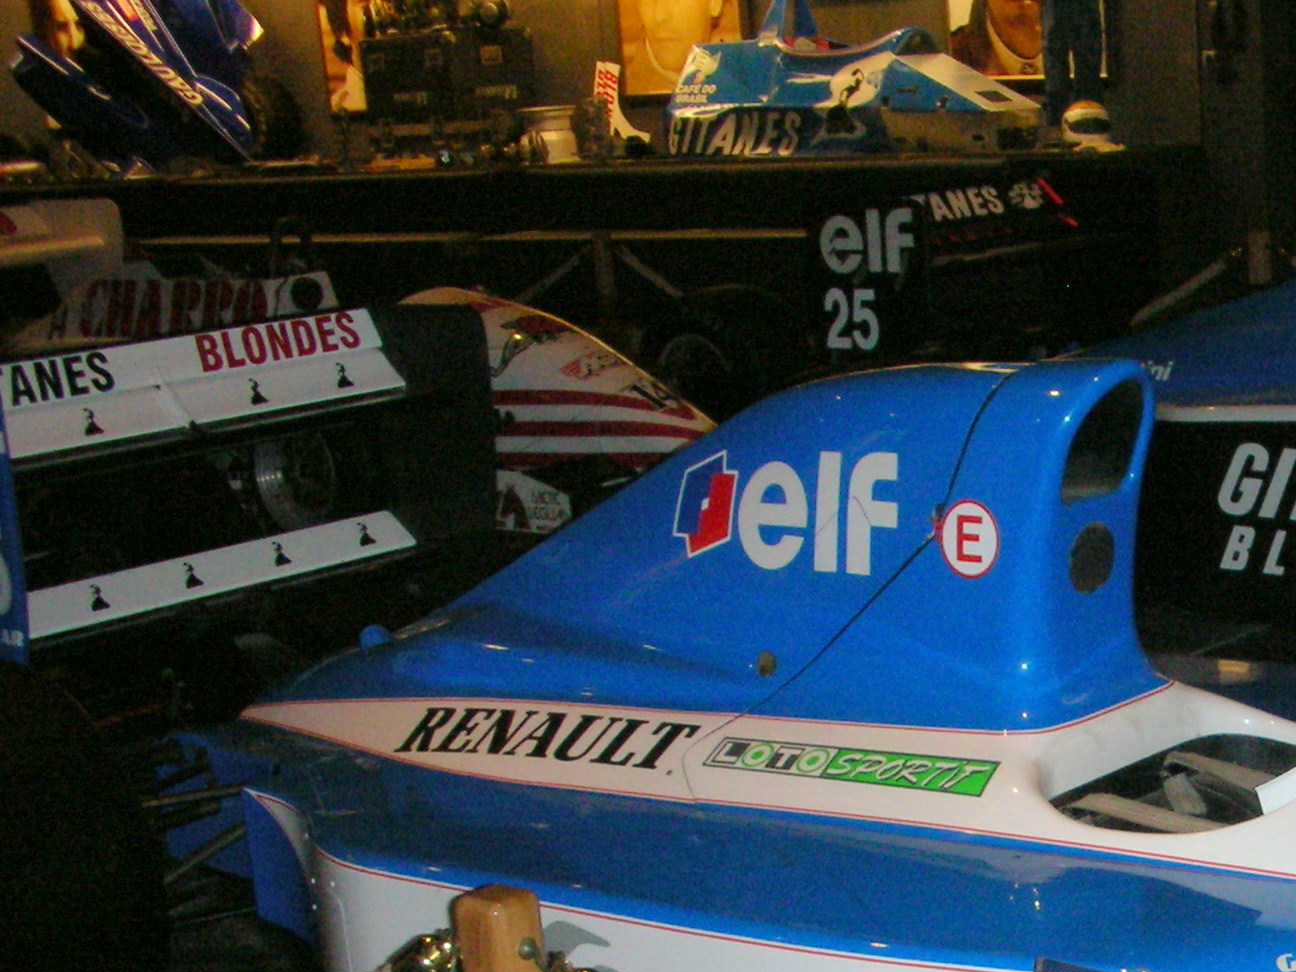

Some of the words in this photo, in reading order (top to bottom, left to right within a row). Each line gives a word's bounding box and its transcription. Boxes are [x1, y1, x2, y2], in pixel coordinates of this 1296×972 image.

[669, 110, 799, 157] GITANES
[819, 206, 915, 275] elf
[824, 287, 880, 350] 25
[0, 351, 116, 406] ANES
[195, 311, 361, 373] BLONDES
[737, 451, 899, 576] elf
[956, 514, 983, 564] E
[394, 705, 702, 770] RENAULT
[711, 742, 830, 775] LOTO
